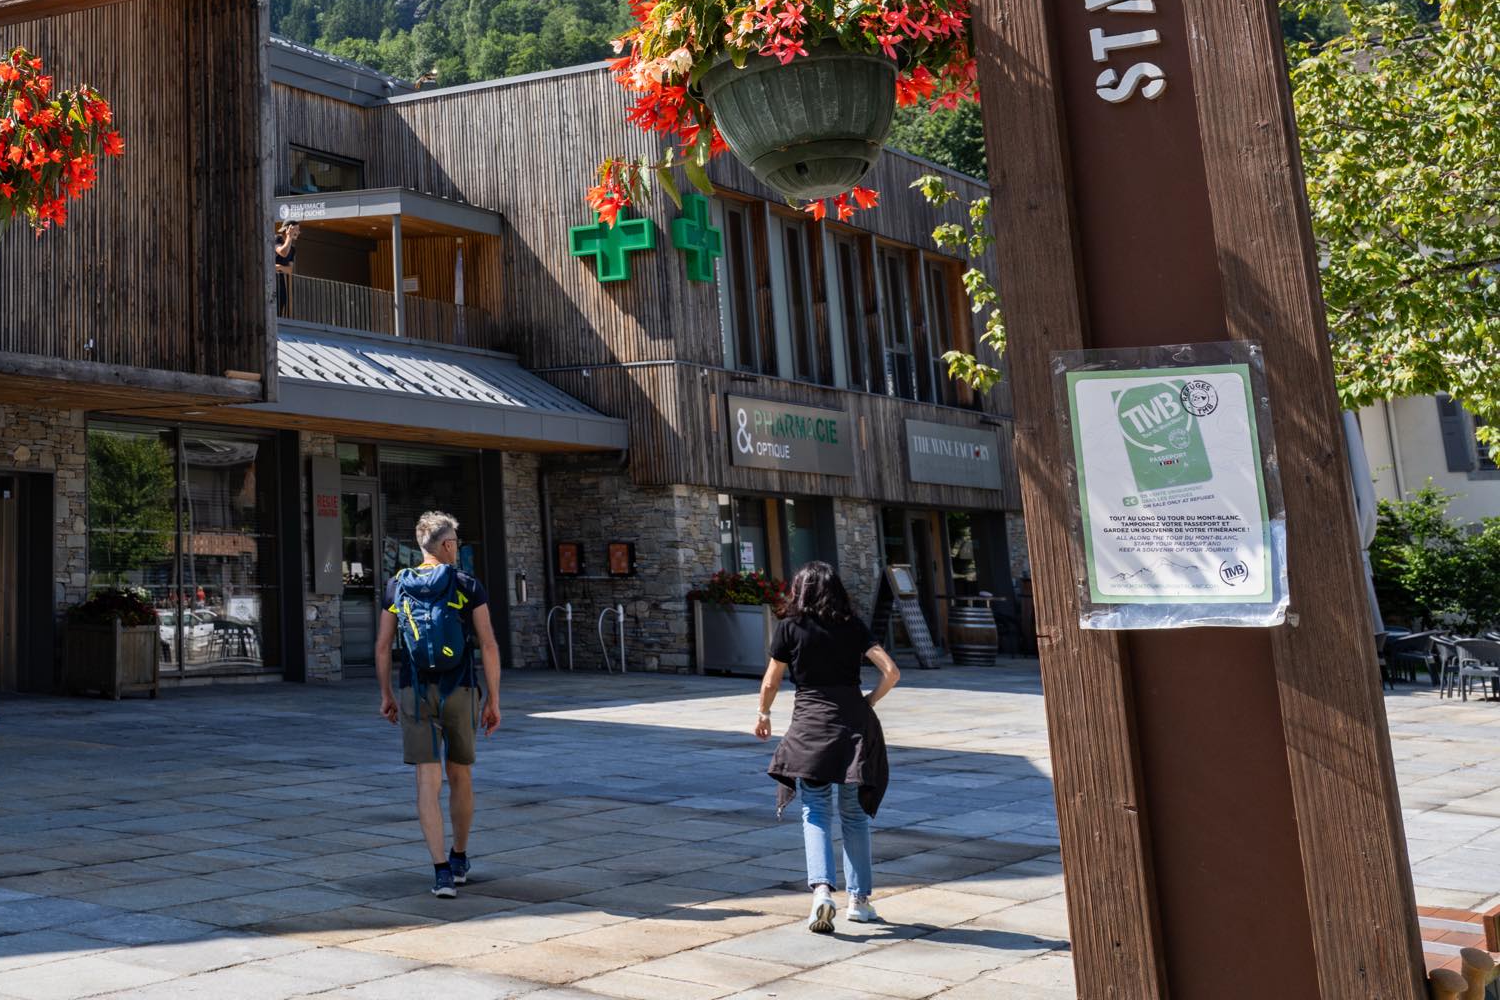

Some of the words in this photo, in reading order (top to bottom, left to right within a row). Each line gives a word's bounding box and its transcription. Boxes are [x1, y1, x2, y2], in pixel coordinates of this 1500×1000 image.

[1181, 382, 1211, 402] REFUGES
[1121, 392, 1181, 434] TMB
[1196, 403, 1214, 415] TMB
[754, 411, 839, 445] PHARMACIE
[756, 441, 790, 459] OPTIQUE
[1222, 564, 1245, 579] TMB
